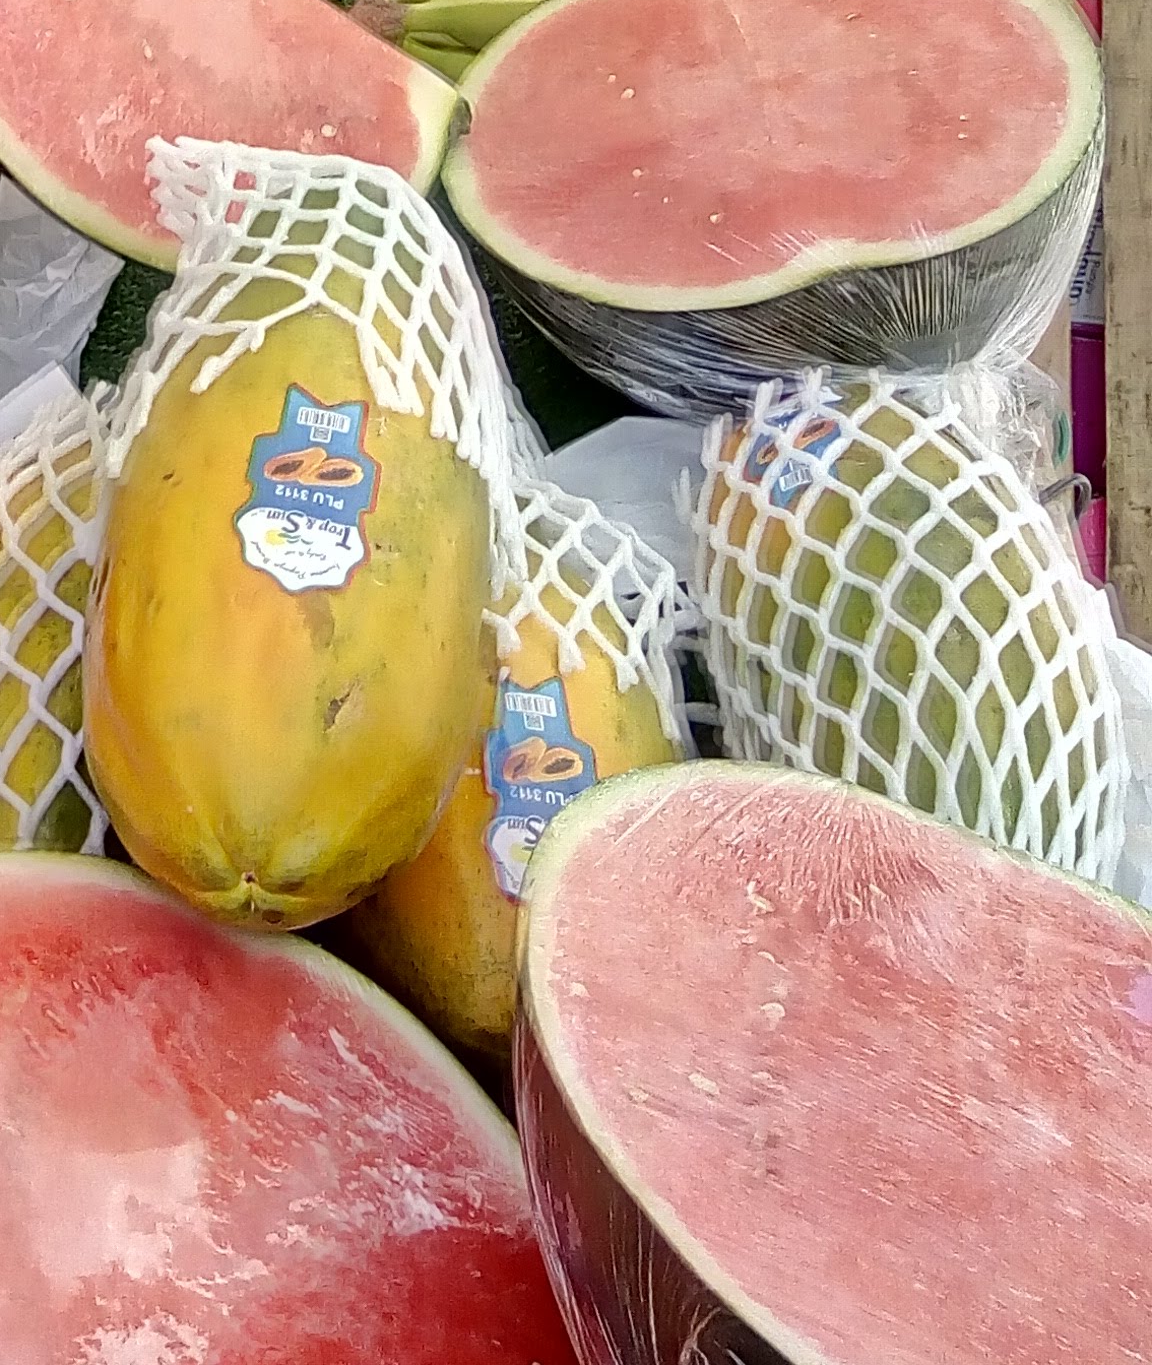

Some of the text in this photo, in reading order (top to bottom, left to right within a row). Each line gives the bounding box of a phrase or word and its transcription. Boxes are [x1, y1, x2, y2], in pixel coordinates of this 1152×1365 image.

[275, 484, 343, 509] PLU 3112
[266, 510, 351, 550] Trop & Sun
[510, 786, 541, 801] 3112
